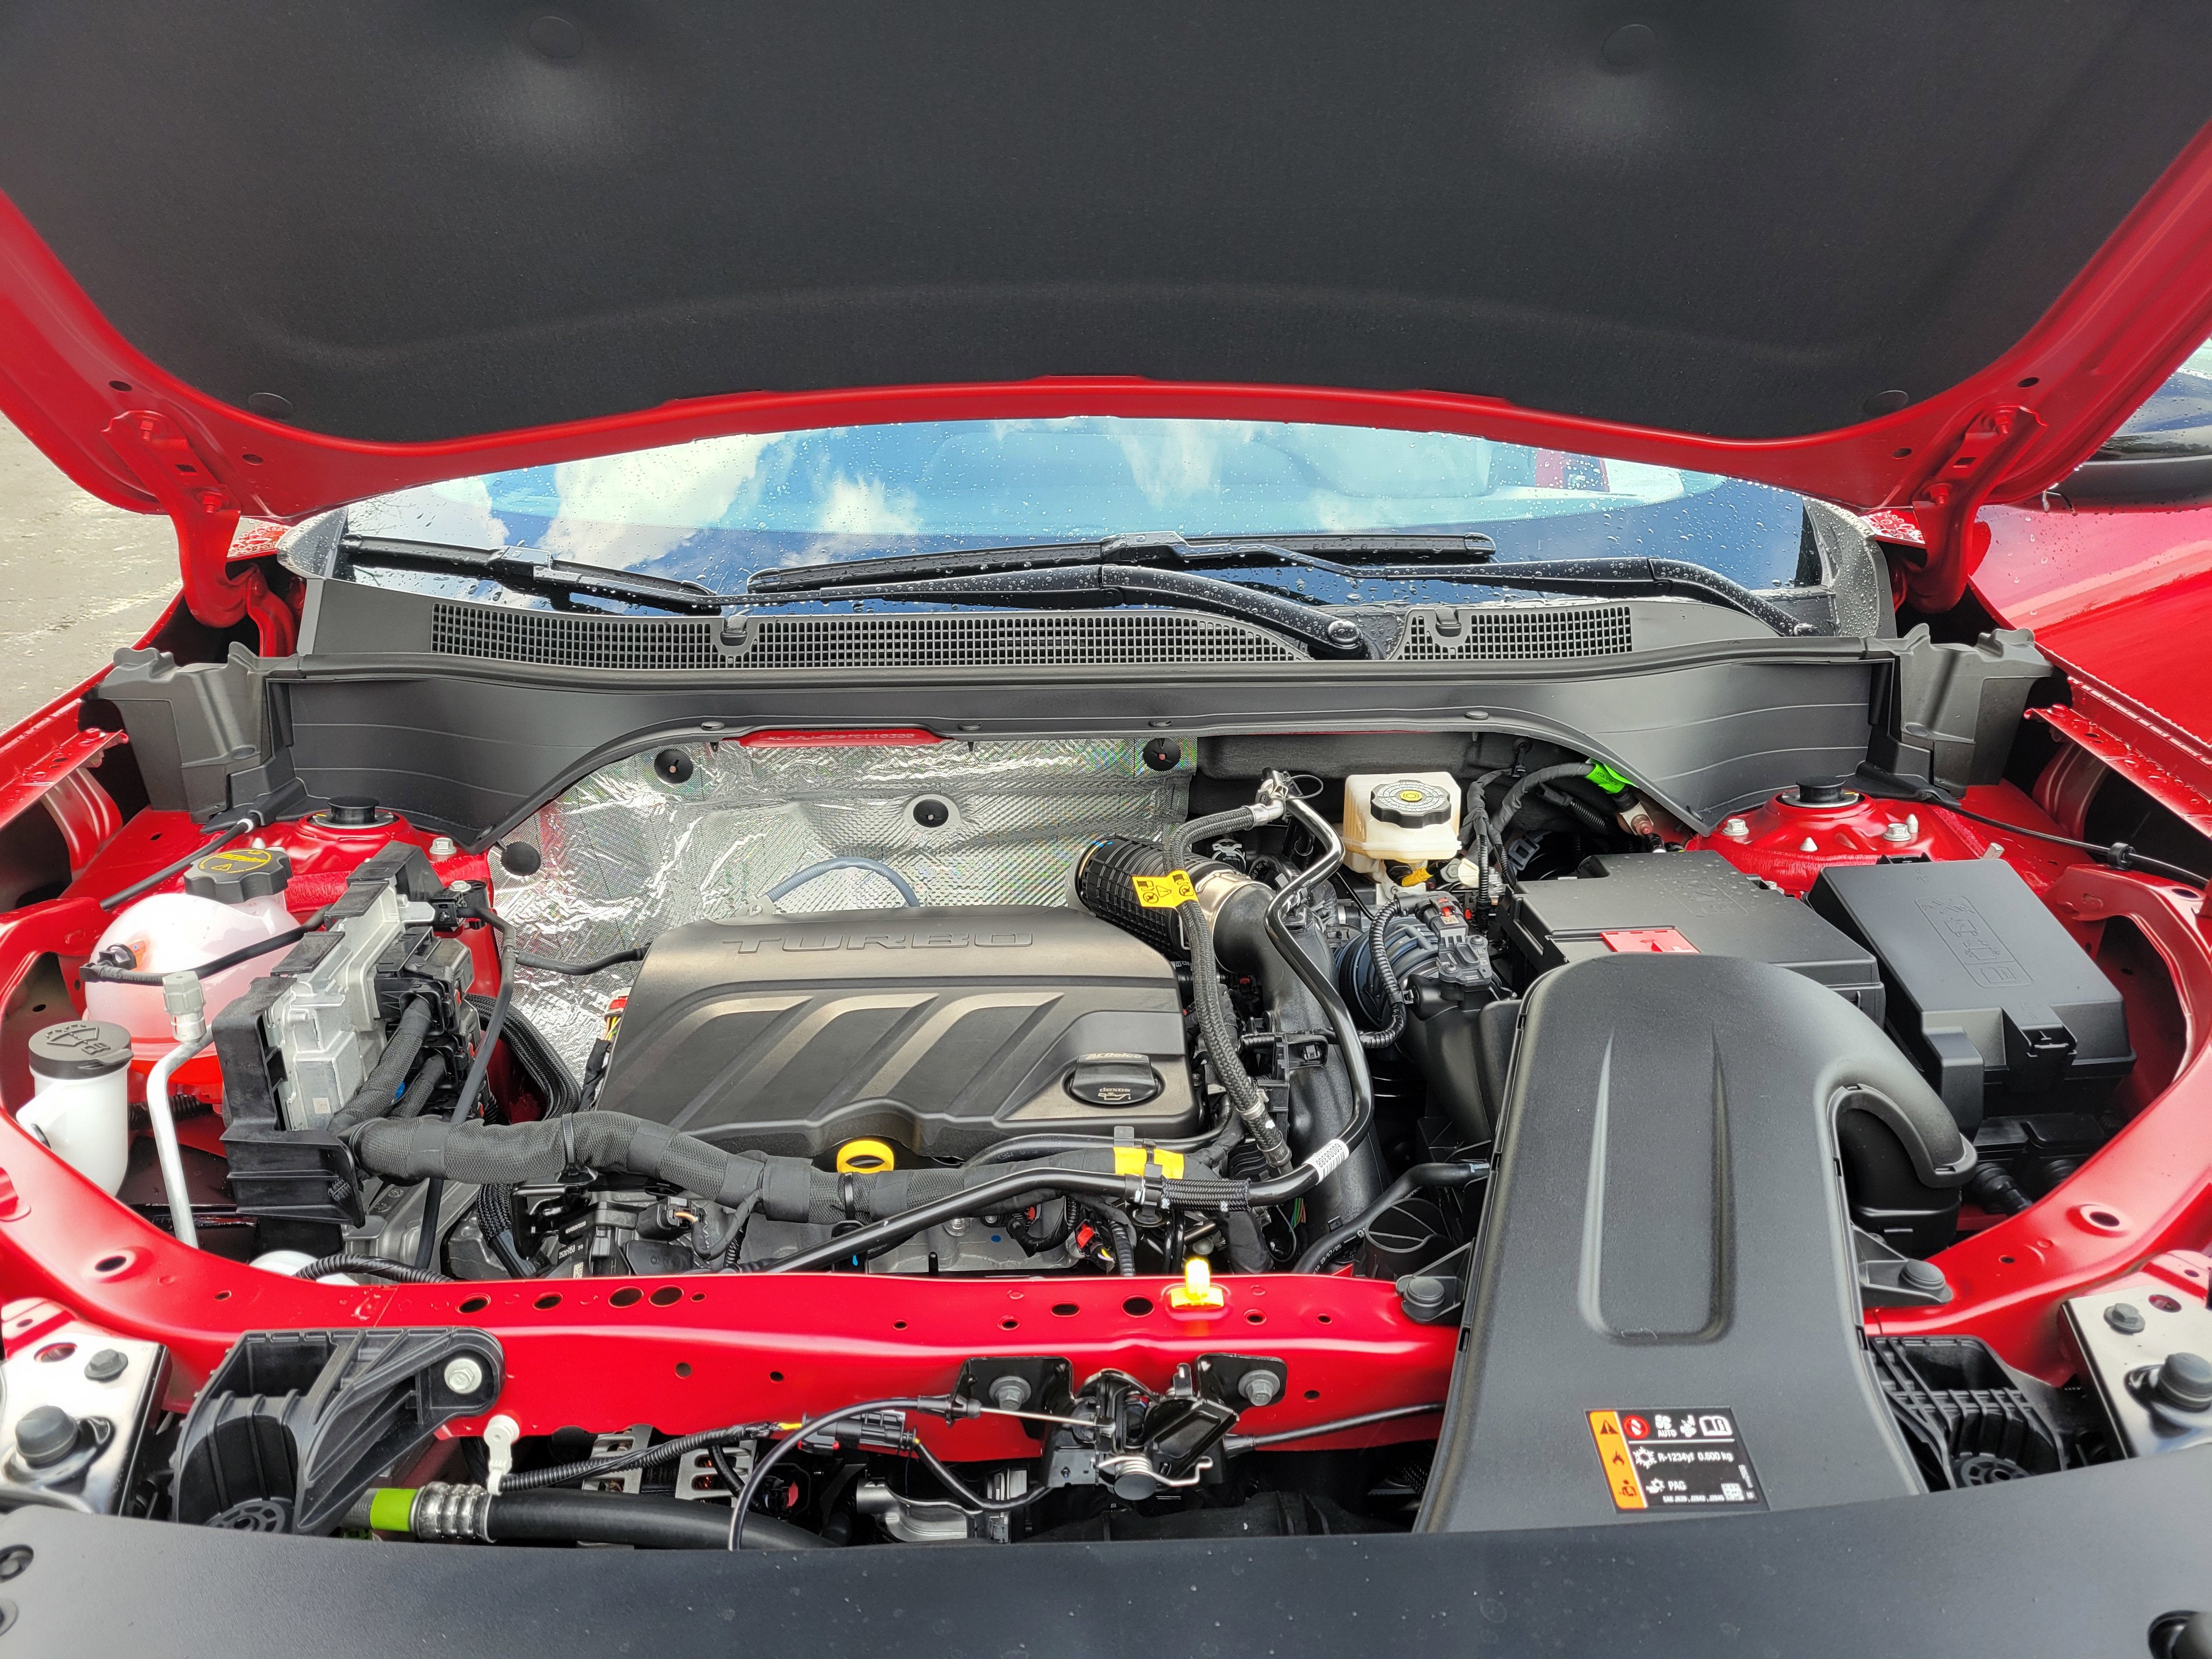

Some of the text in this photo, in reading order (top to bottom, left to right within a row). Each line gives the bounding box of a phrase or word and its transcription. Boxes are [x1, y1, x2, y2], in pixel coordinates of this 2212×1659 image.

[723, 933, 1033, 954] TURBO
[1316, 1143, 1342, 1168] 60008388
[1658, 1429, 1678, 1438] AUTO
[1721, 1451, 1734, 1463] kg
[1667, 1480, 1688, 1492] PAG
